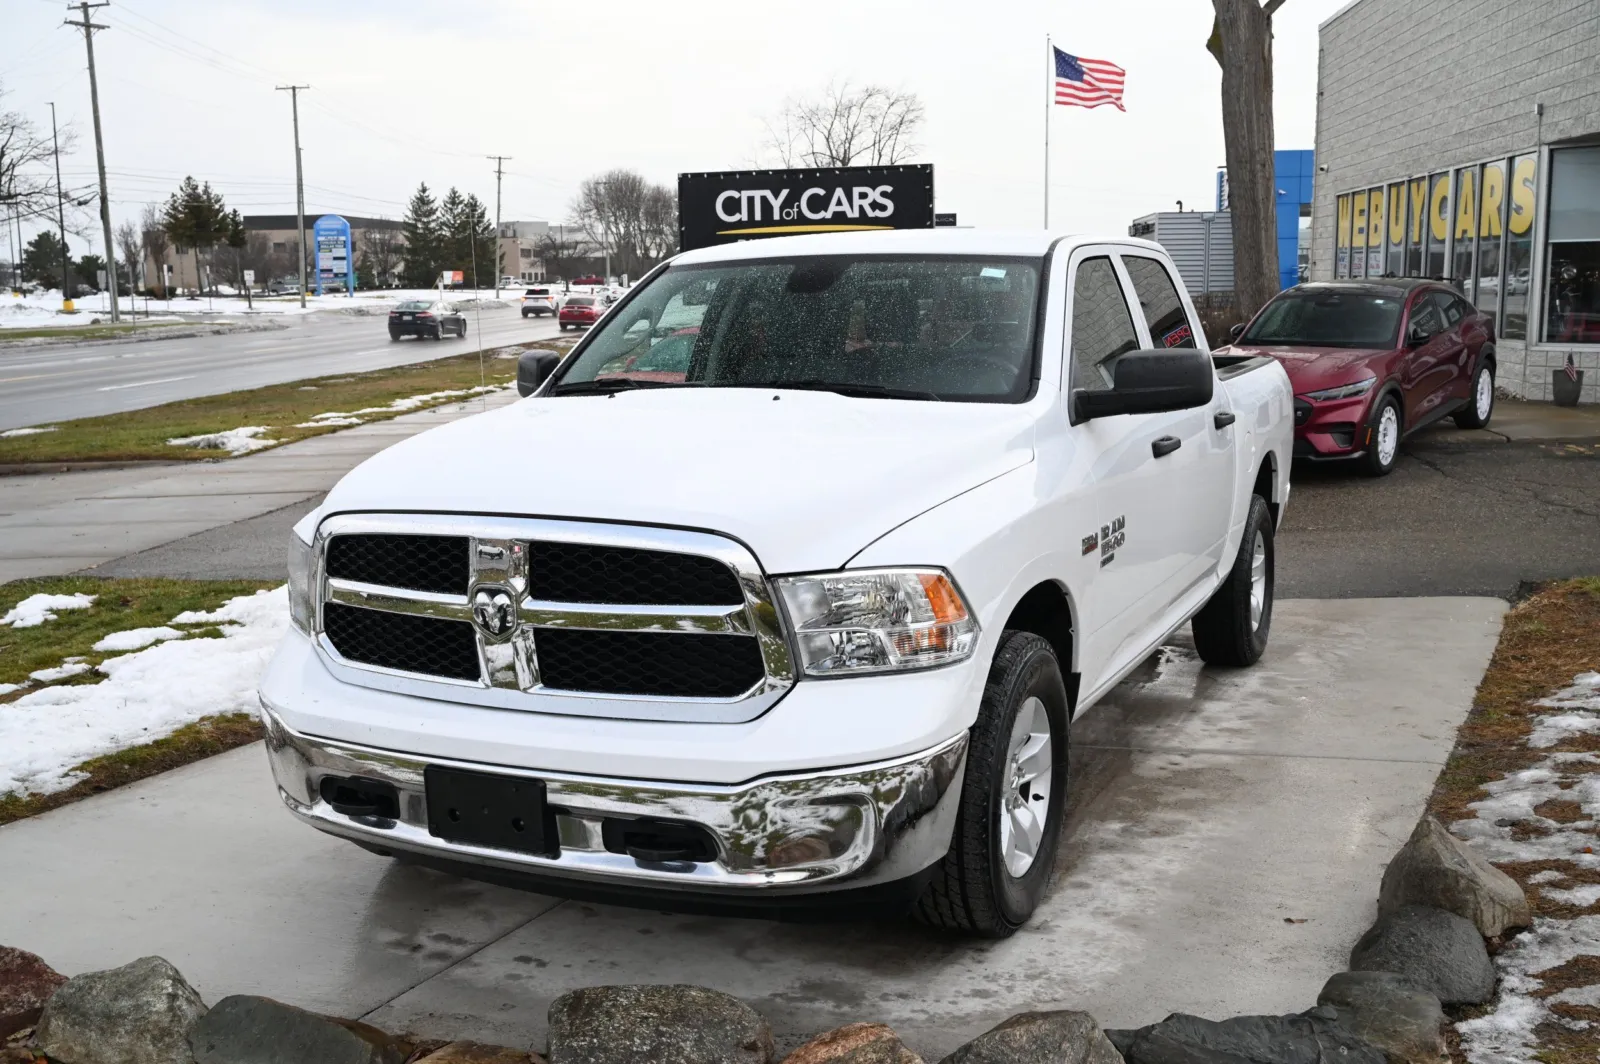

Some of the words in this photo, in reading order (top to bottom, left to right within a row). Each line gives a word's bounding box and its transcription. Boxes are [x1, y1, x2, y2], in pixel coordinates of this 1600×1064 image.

[715, 188, 790, 223] CITY
[782, 202, 800, 221] of
[799, 185, 895, 220] CARS
[1430, 157, 1536, 240] CARS
[1101, 514, 1125, 541] RAM
